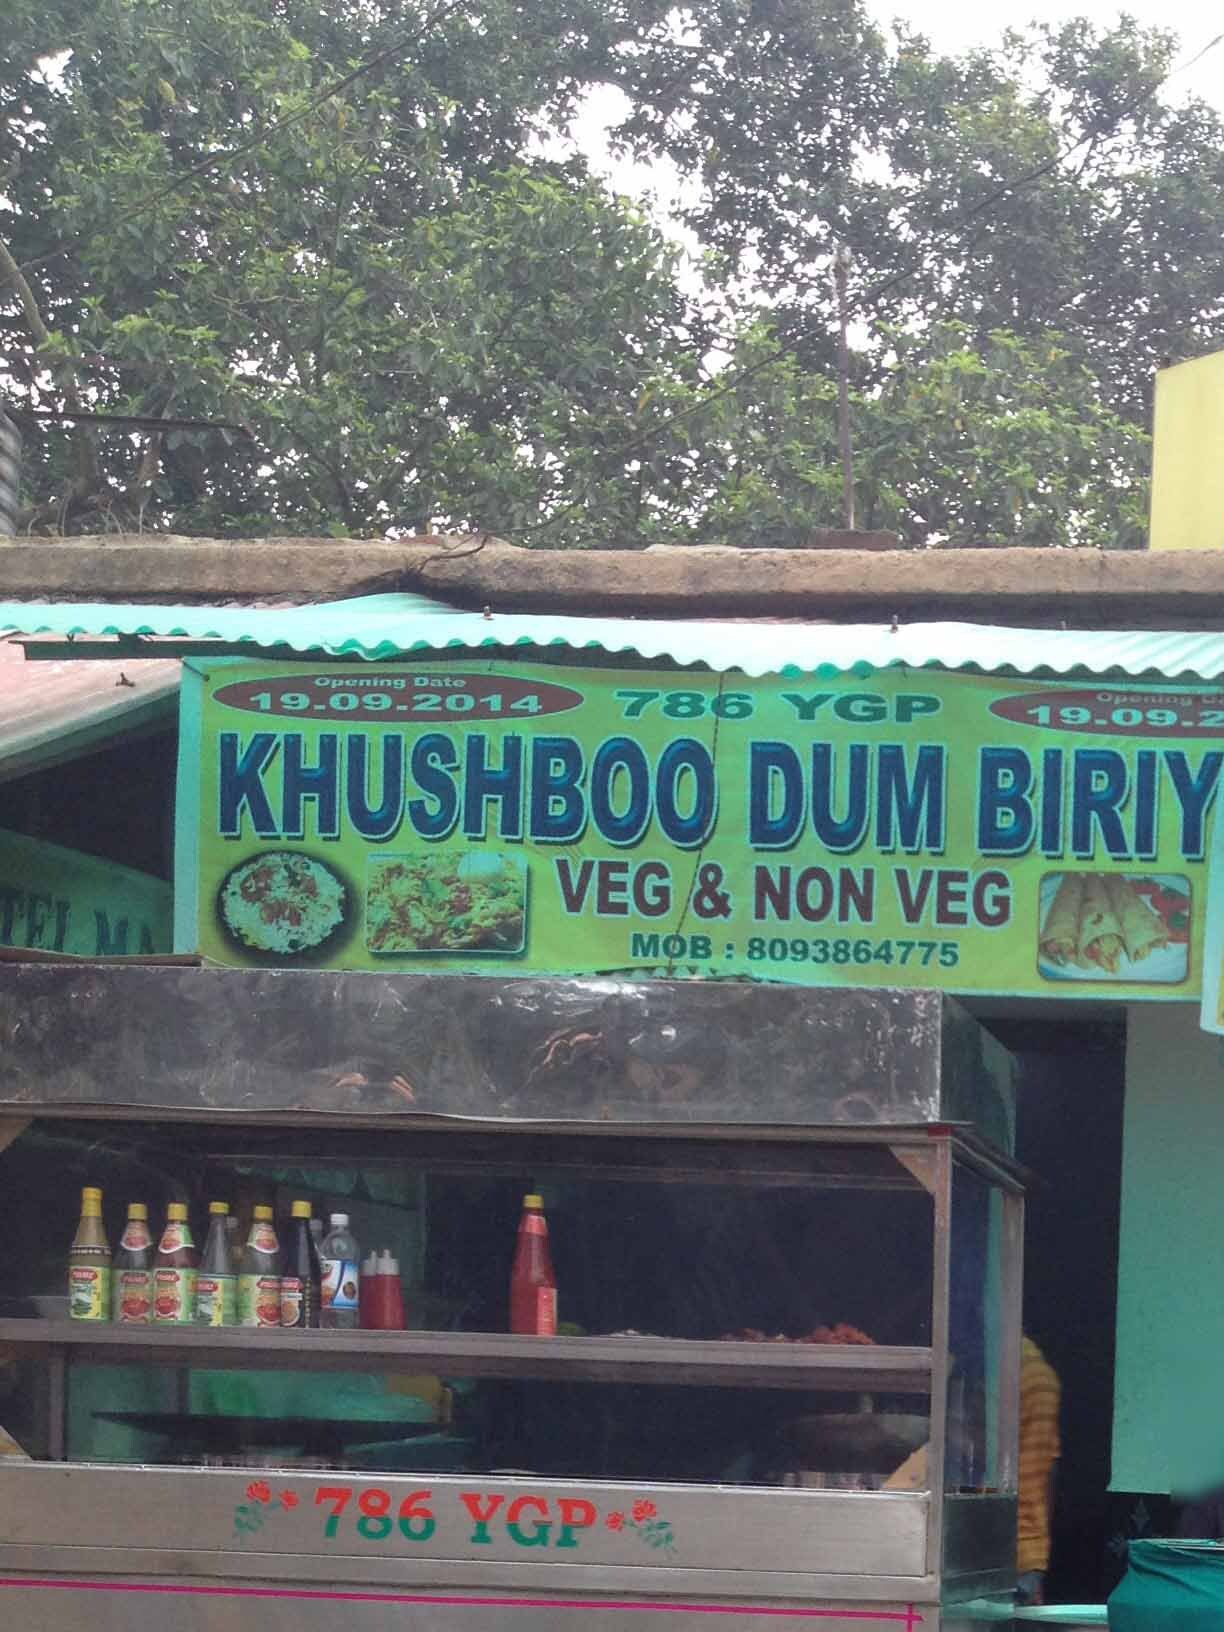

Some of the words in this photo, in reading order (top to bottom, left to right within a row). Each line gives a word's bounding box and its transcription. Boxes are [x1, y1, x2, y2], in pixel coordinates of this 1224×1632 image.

[314, 675, 406, 692] Opening
[412, 675, 467, 689] Date
[248, 692, 543, 714] 19.09.2014
[614, 690, 755, 720] 786
[782, 692, 943, 723] YGP
[217, 731, 718, 850] KHUSHBOO
[748, 740, 948, 855] DUM
[976, 744, 1224, 862] BIRIY
[553, 857, 673, 918] VEG
[692, 857, 733, 920] &
[752, 865, 876, 924] NON
[894, 867, 1012, 928] VEG
[630, 932, 713, 959] MOB
[746, 937, 960, 968] 8093864775
[314, 1487, 436, 1544] 786
[458, 1492, 599, 1550] YGP
